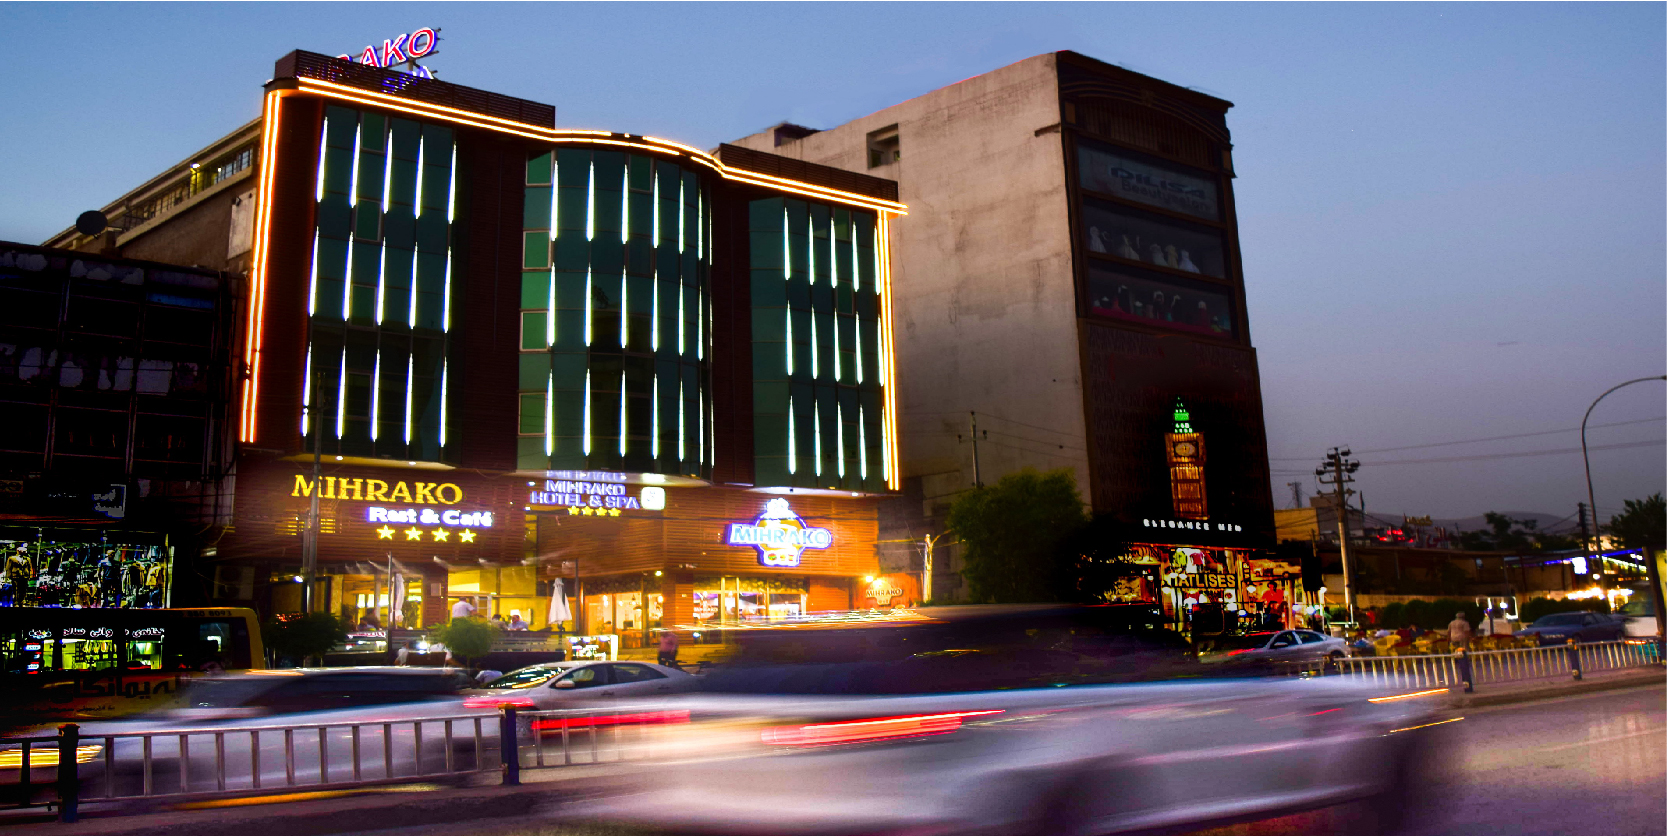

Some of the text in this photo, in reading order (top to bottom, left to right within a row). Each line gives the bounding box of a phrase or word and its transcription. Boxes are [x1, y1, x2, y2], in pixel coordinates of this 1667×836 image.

[291, 474, 463, 504] MIHRAKO
[545, 479, 627, 497] MIHRAKO
[530, 490, 641, 510] HOTEL & SPA
[420, 507, 441, 525] &
[733, 526, 828, 545] MIHRAKO
